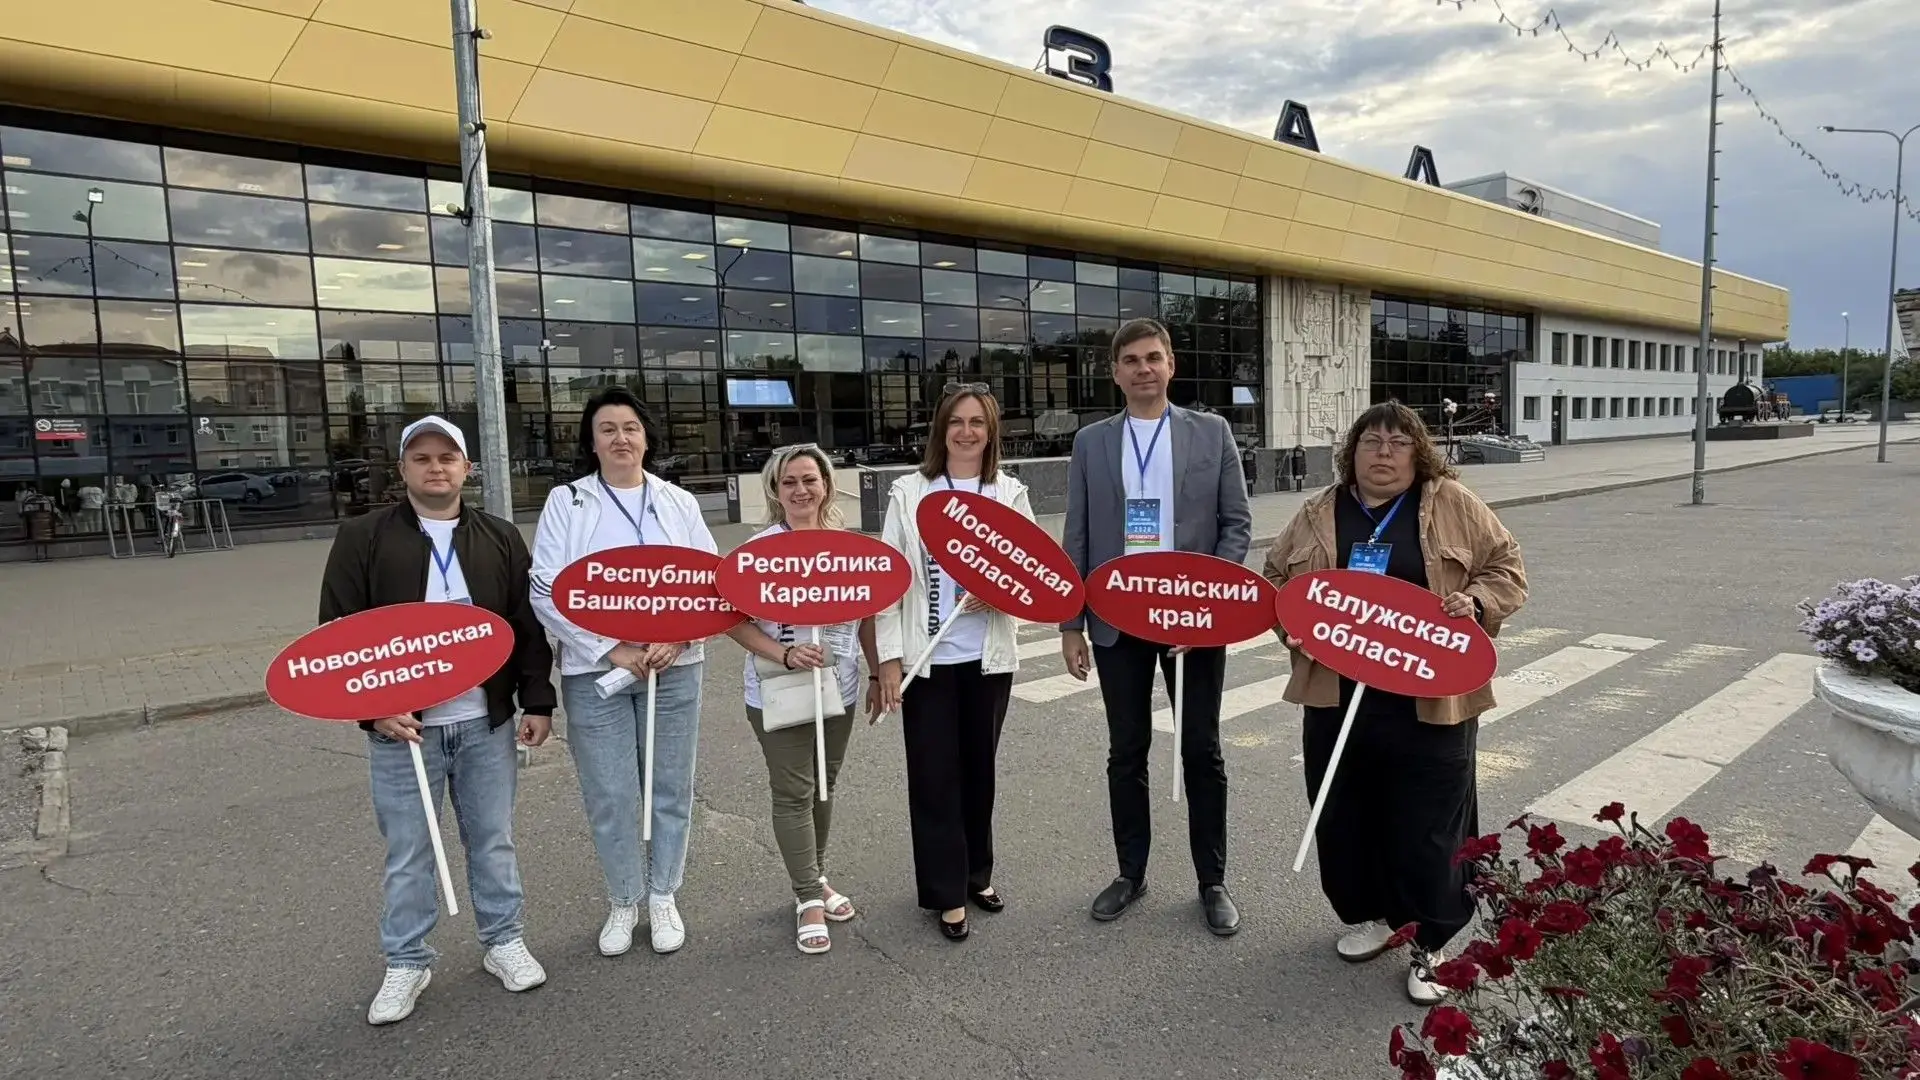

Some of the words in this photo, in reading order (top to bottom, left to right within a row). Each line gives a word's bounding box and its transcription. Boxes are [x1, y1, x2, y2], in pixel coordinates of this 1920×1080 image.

[943, 497, 1073, 596] Московская
[587, 562, 716, 588] Республик
[738, 551, 891, 577] Республика
[947, 539, 1033, 605] область
[761, 582, 870, 607] Карелия
[1106, 570, 1257, 601] Алтайский
[569, 590, 736, 615] Башкортоста
[1149, 606, 1211, 629] край
[1307, 578, 1470, 653] Калужская
[288, 623, 493, 678] Новосибирская
[1313, 623, 1435, 679] область
[346, 659, 453, 692] область
